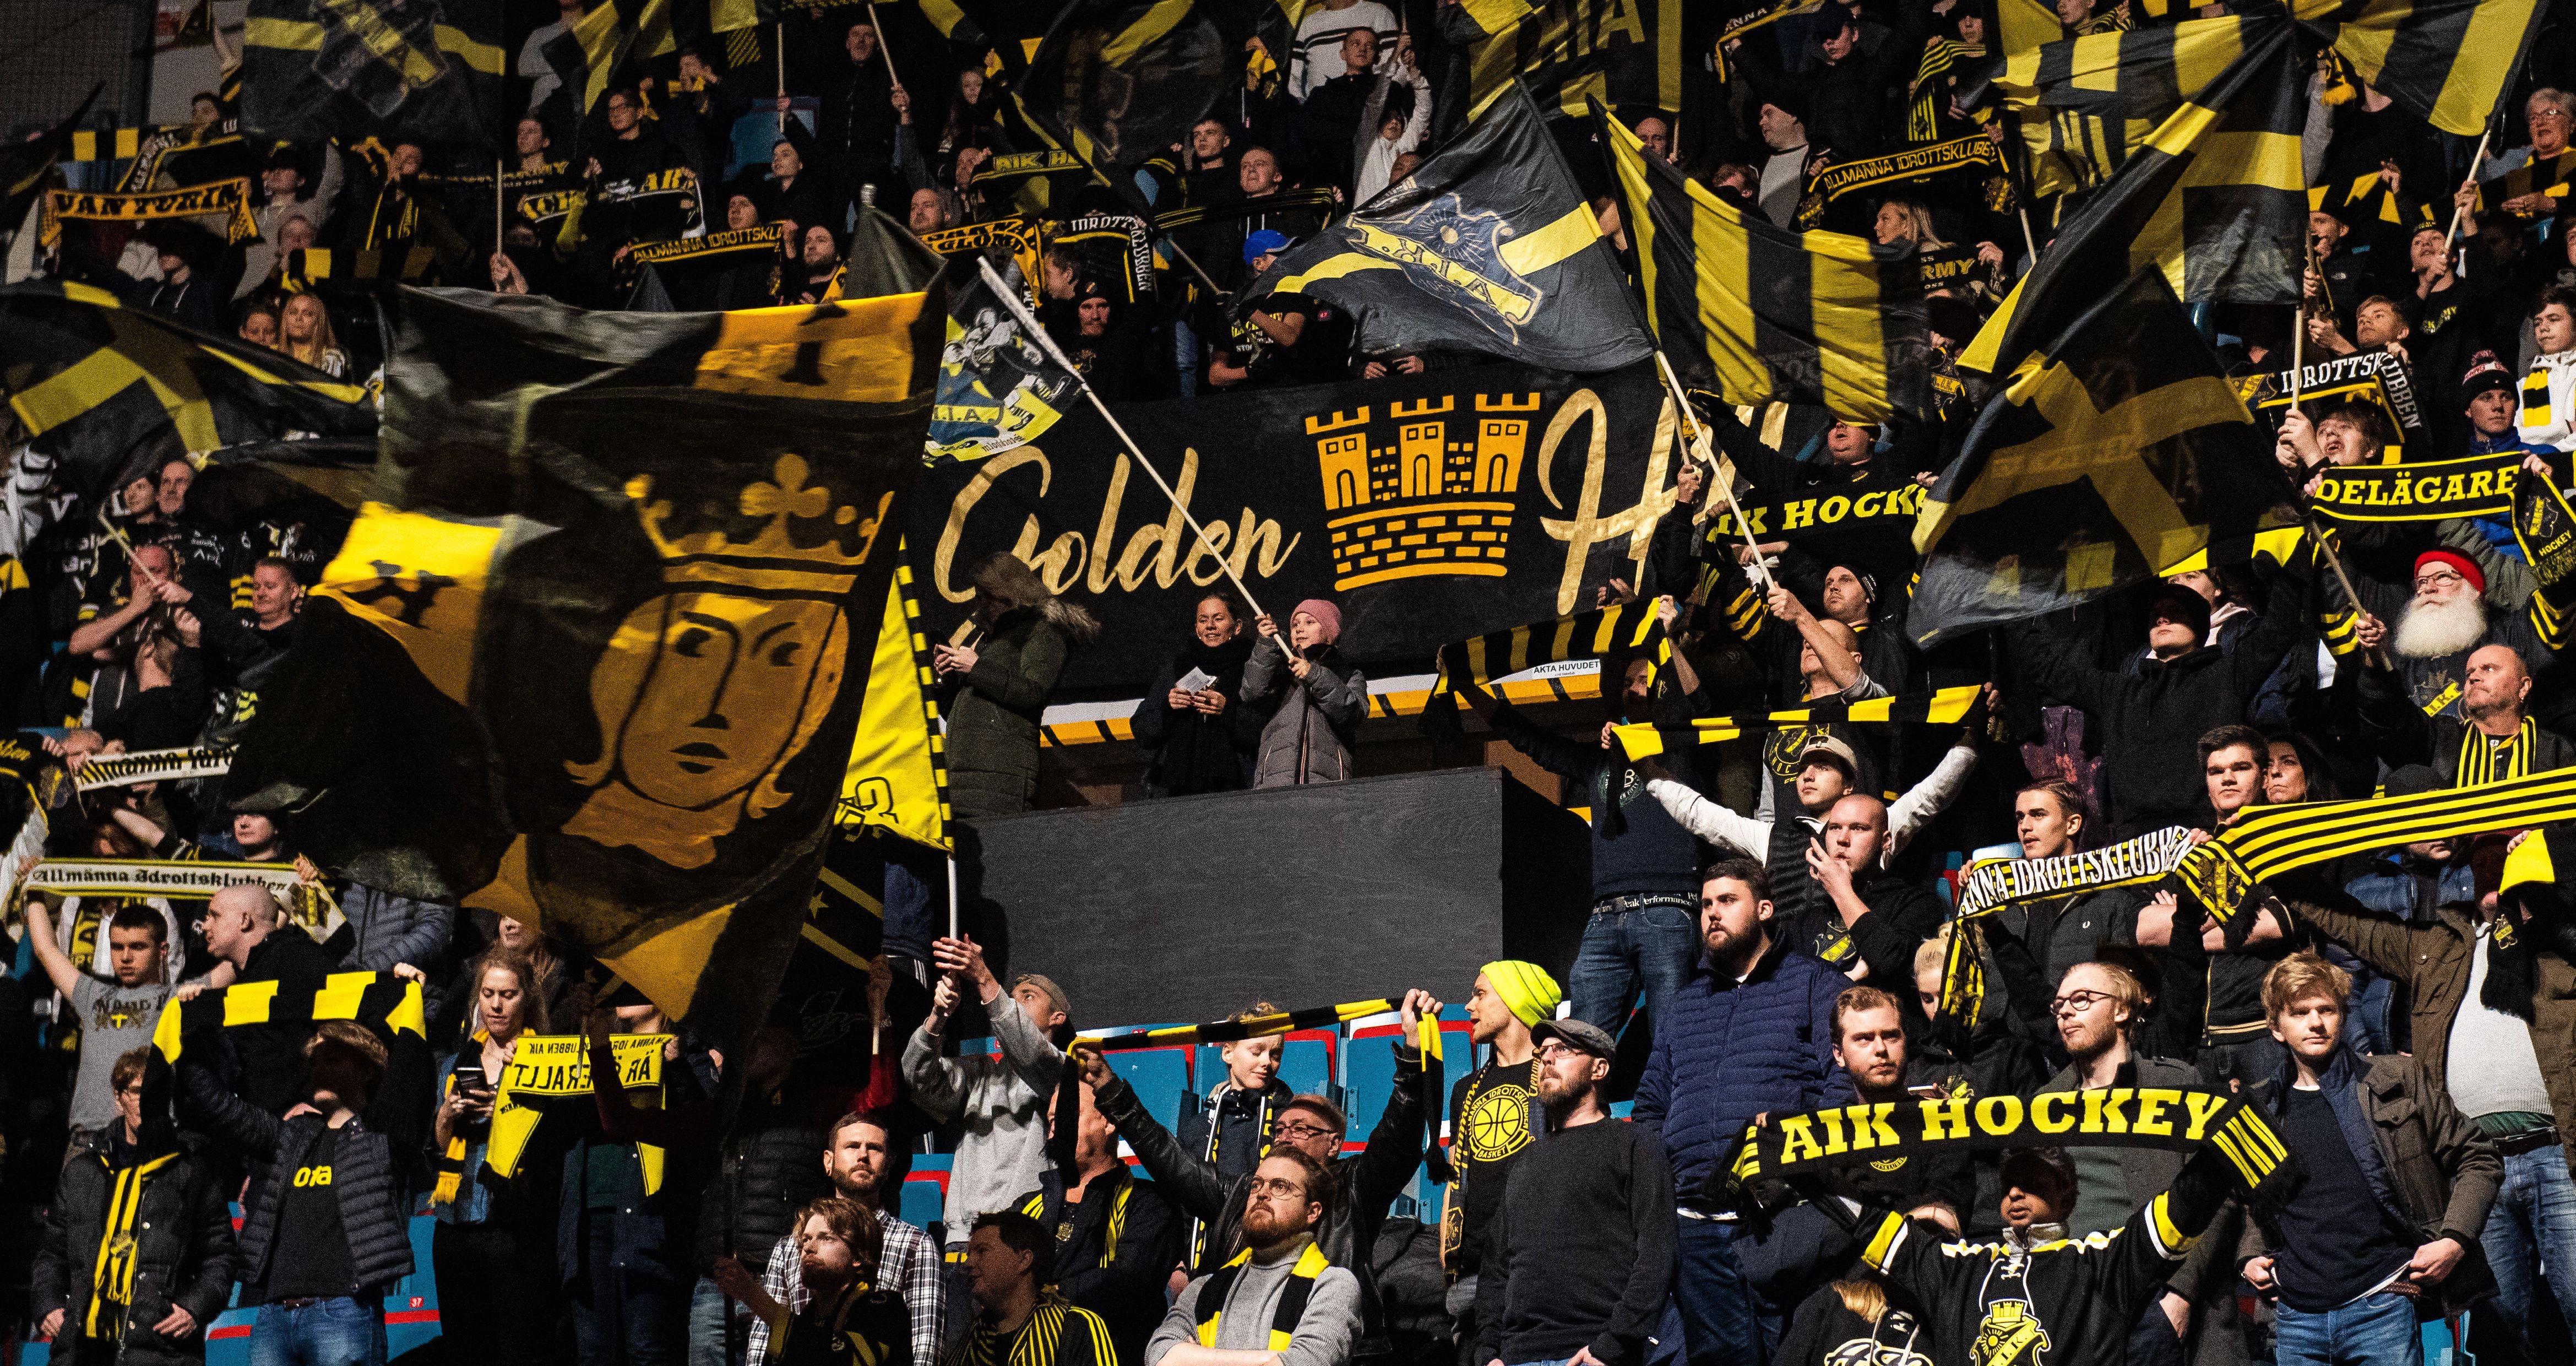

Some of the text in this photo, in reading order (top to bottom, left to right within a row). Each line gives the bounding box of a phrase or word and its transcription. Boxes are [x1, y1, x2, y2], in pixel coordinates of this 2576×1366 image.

[1920, 259, 1976, 280] RMY
[2314, 465, 2520, 506] DELÄGARE
[933, 445, 1303, 604] Golden
[2538, 529, 2573, 557] HOCKEY
[1643, 895, 1693, 909] erformance
[1780, 1088, 2228, 1164] AIK HOCKEY
